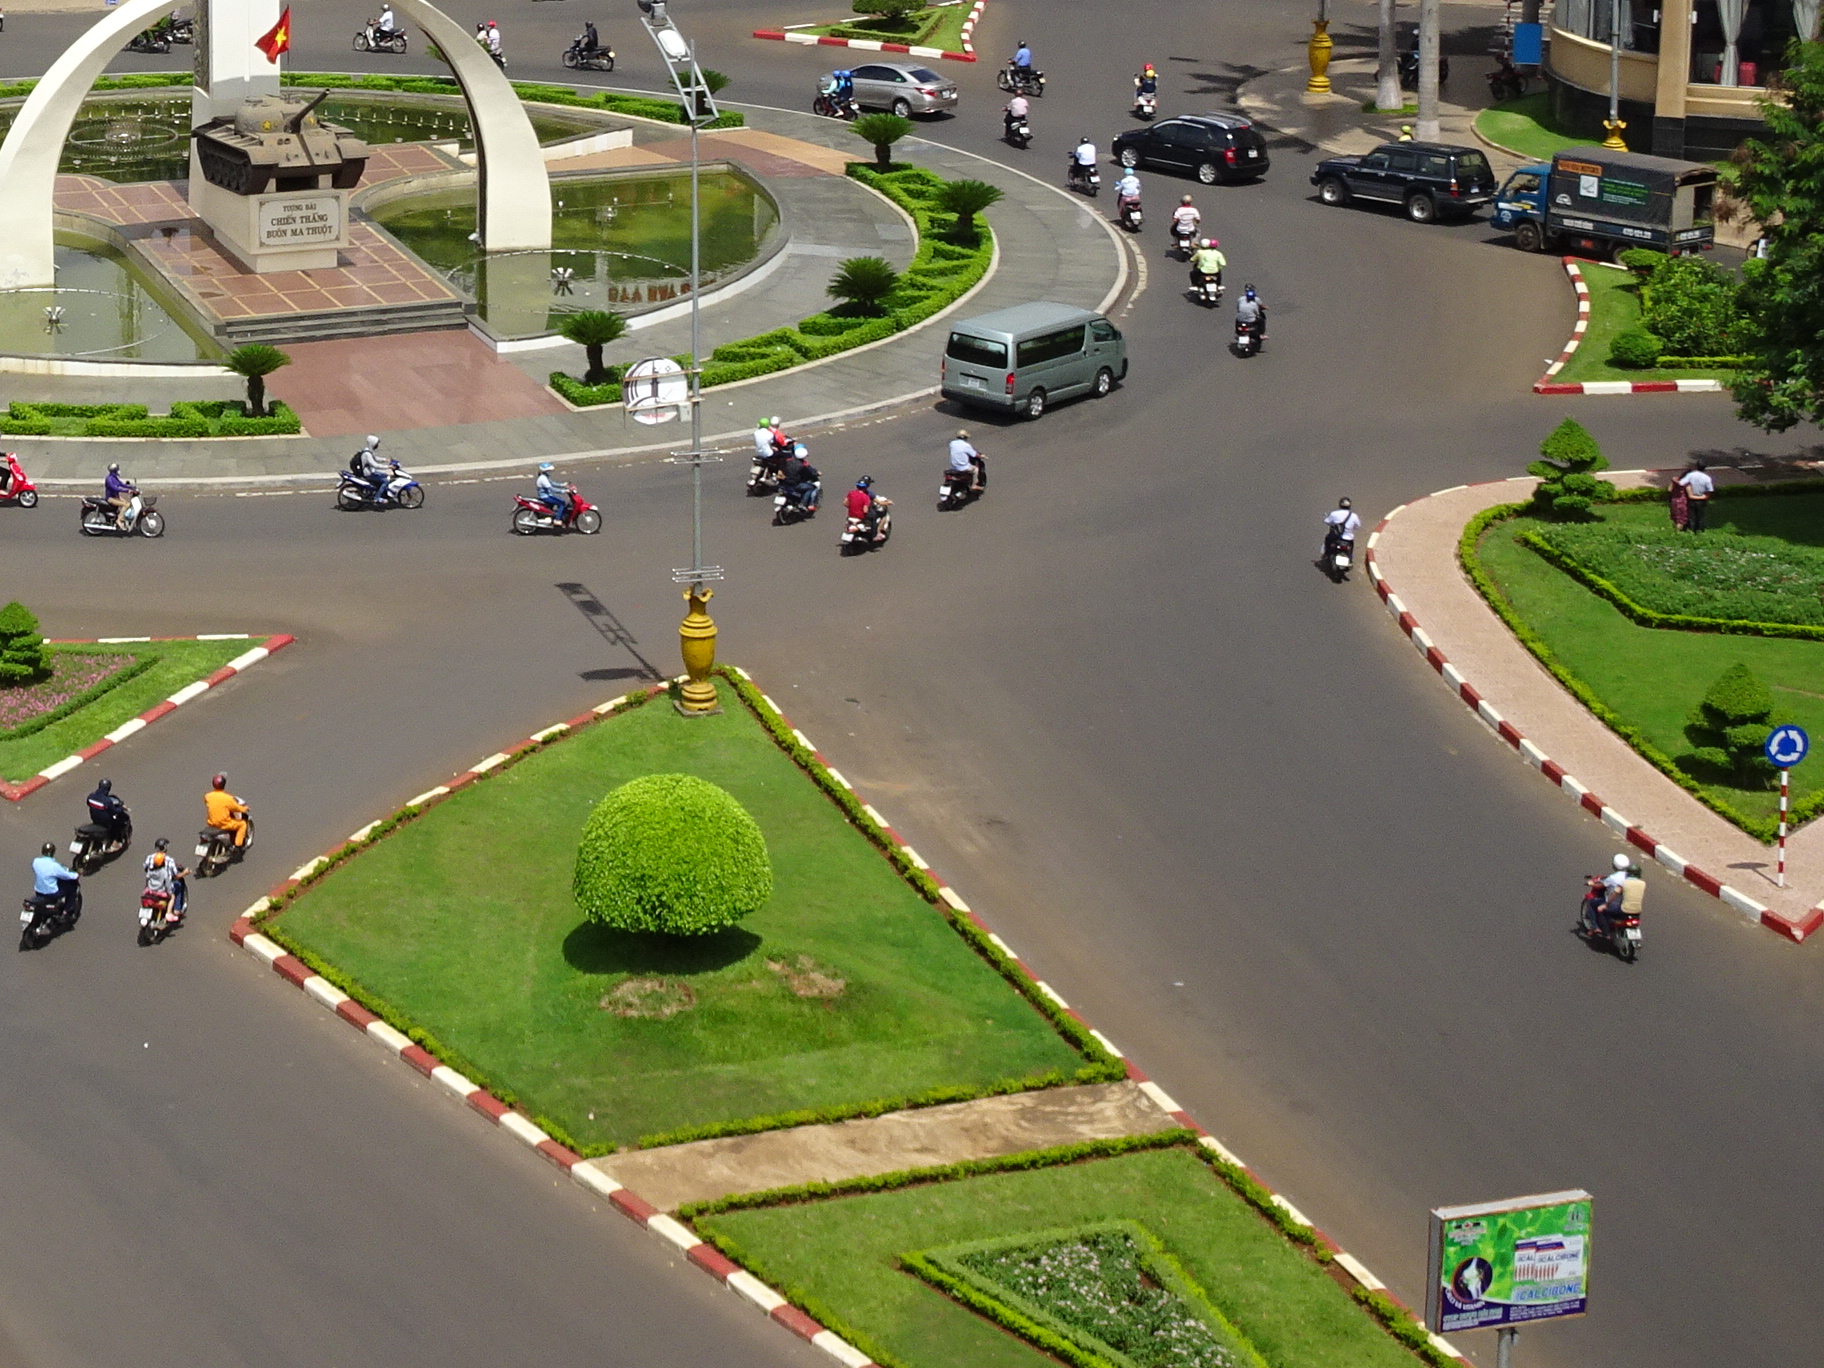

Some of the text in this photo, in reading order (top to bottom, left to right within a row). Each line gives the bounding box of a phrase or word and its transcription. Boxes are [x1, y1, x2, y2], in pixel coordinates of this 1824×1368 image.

[270, 212, 328, 226] CHIẾN THẮNG
[266, 224, 334, 239] BUÔN MA THUỘT
